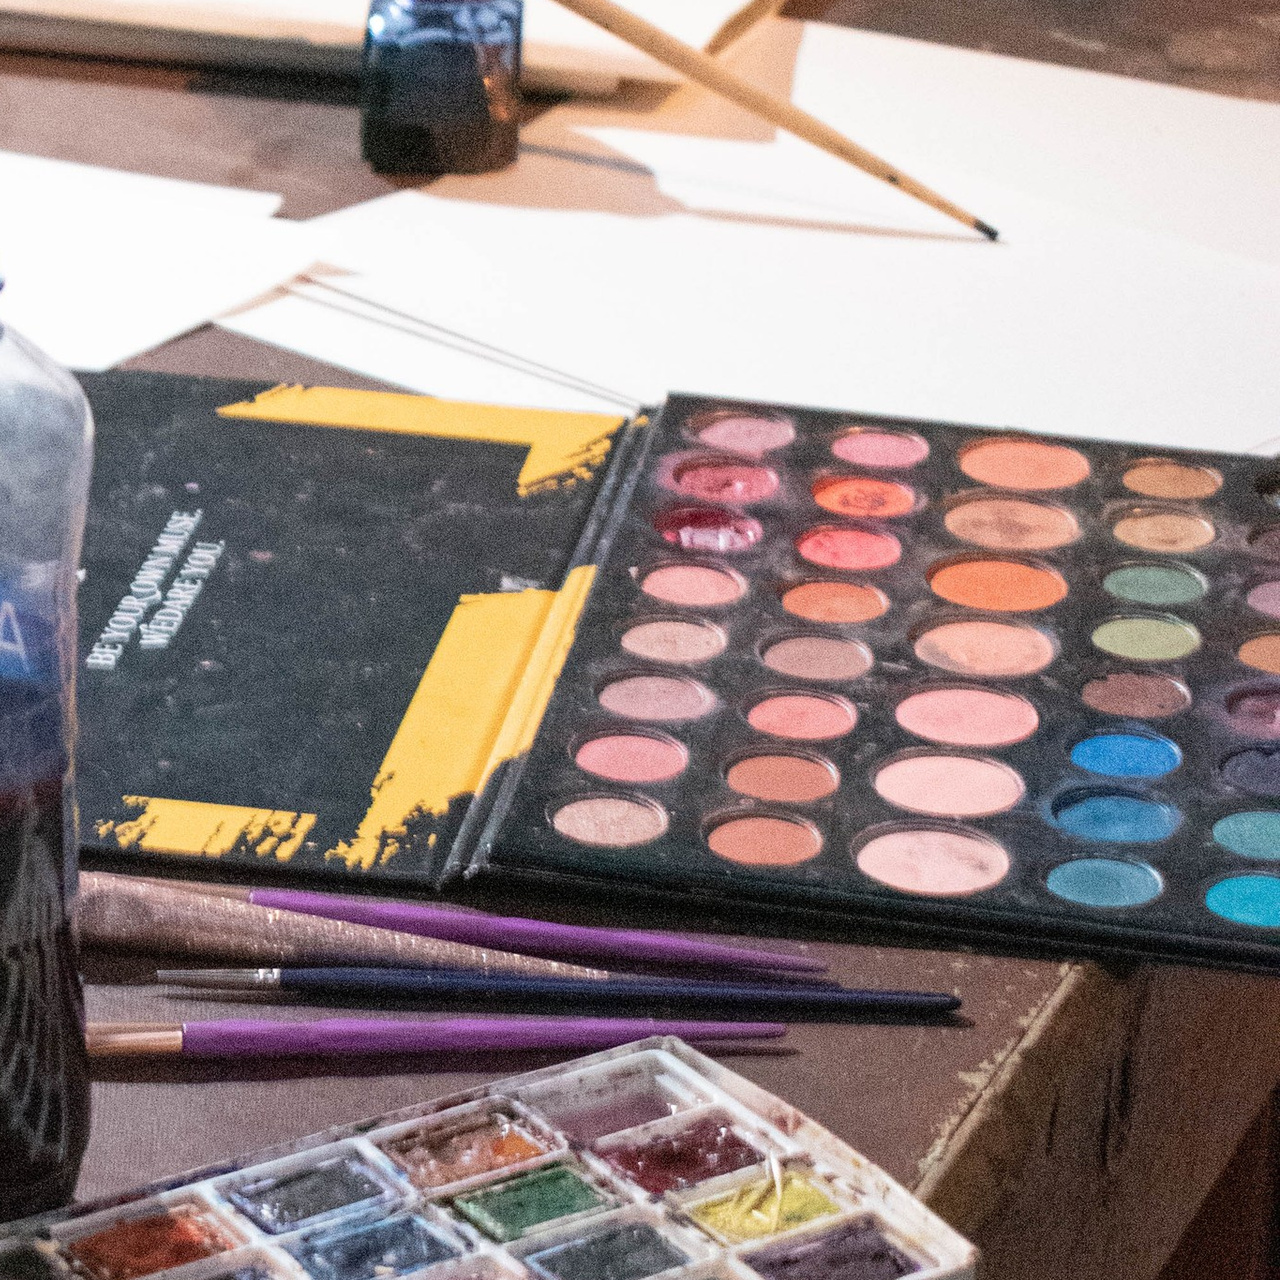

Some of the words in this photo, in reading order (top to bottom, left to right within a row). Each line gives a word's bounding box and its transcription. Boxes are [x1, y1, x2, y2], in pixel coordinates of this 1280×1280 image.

[130, 555, 172, 594] OWN
[100, 590, 162, 642] YOUR
[86, 642, 123, 670] BE
